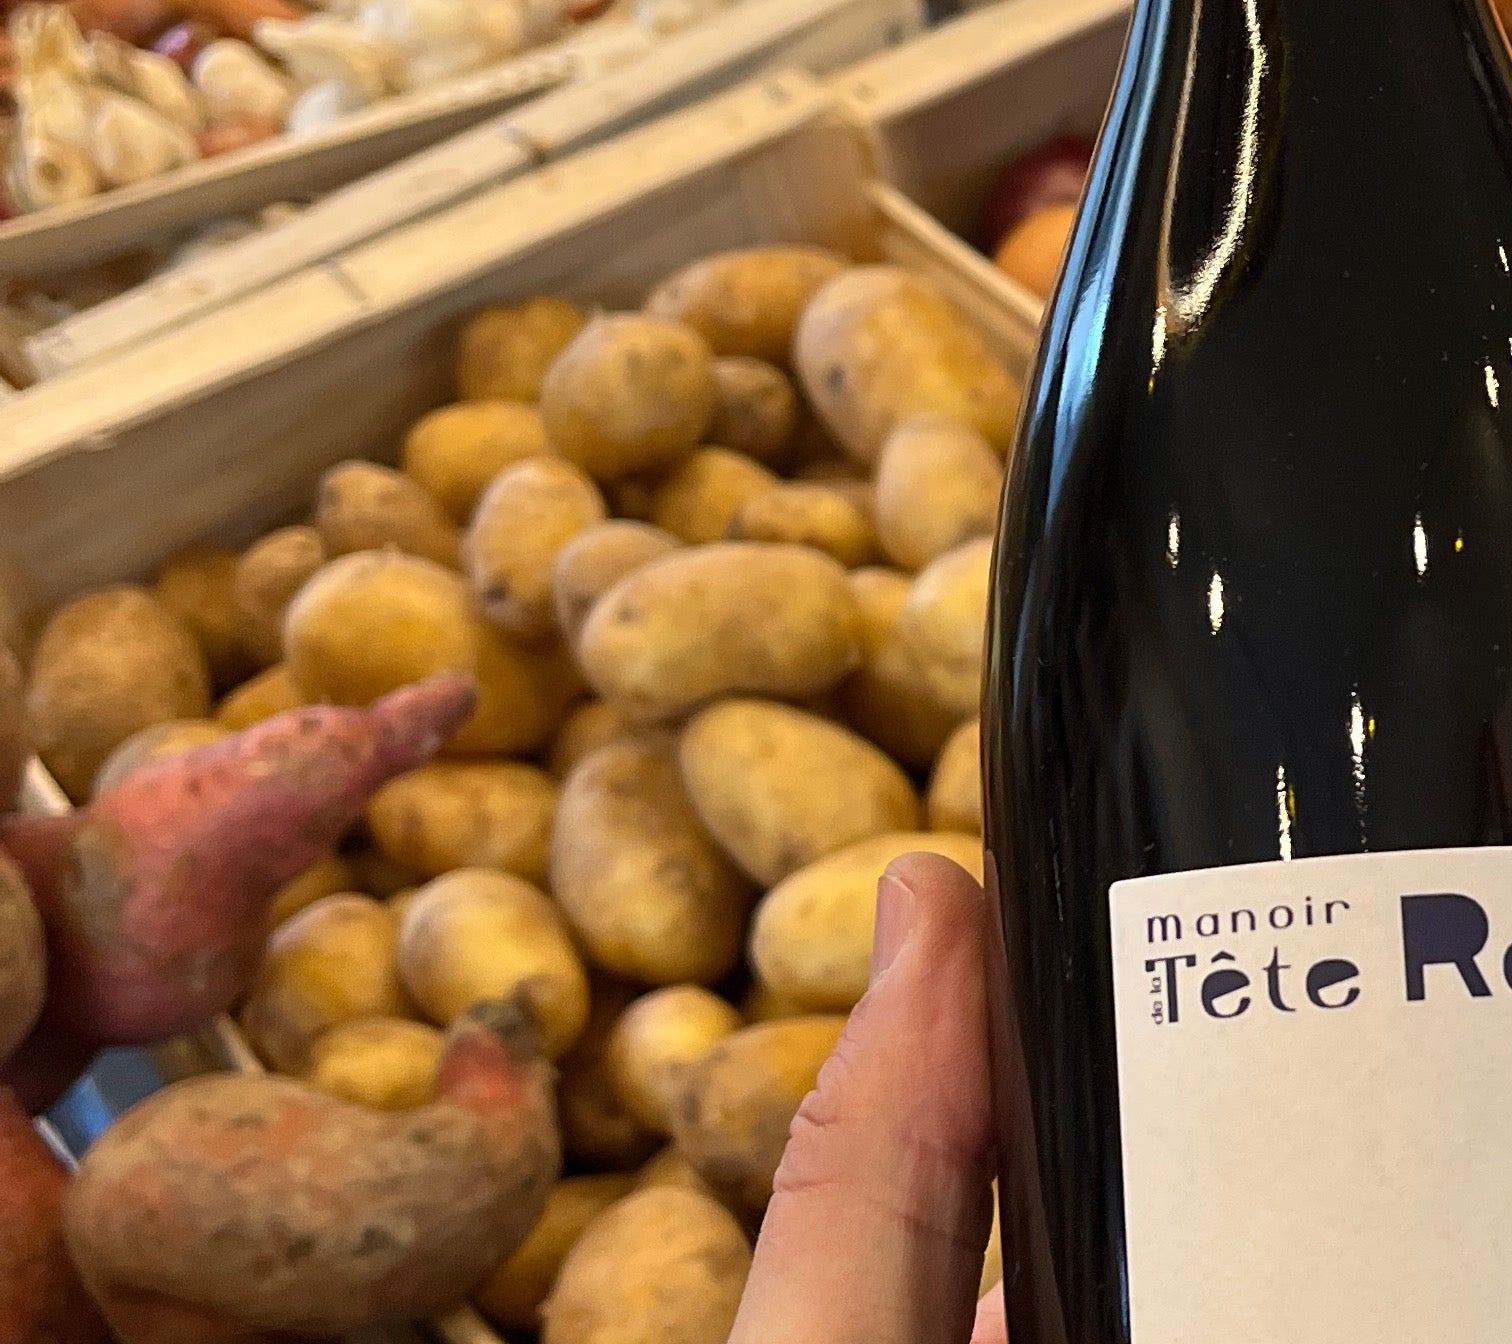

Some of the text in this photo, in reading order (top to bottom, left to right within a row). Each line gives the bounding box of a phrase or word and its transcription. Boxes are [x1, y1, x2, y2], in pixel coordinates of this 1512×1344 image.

[1146, 896, 1351, 943] manoir
[1145, 945, 1361, 1024] Tête
[1149, 976, 1164, 1025] de la
